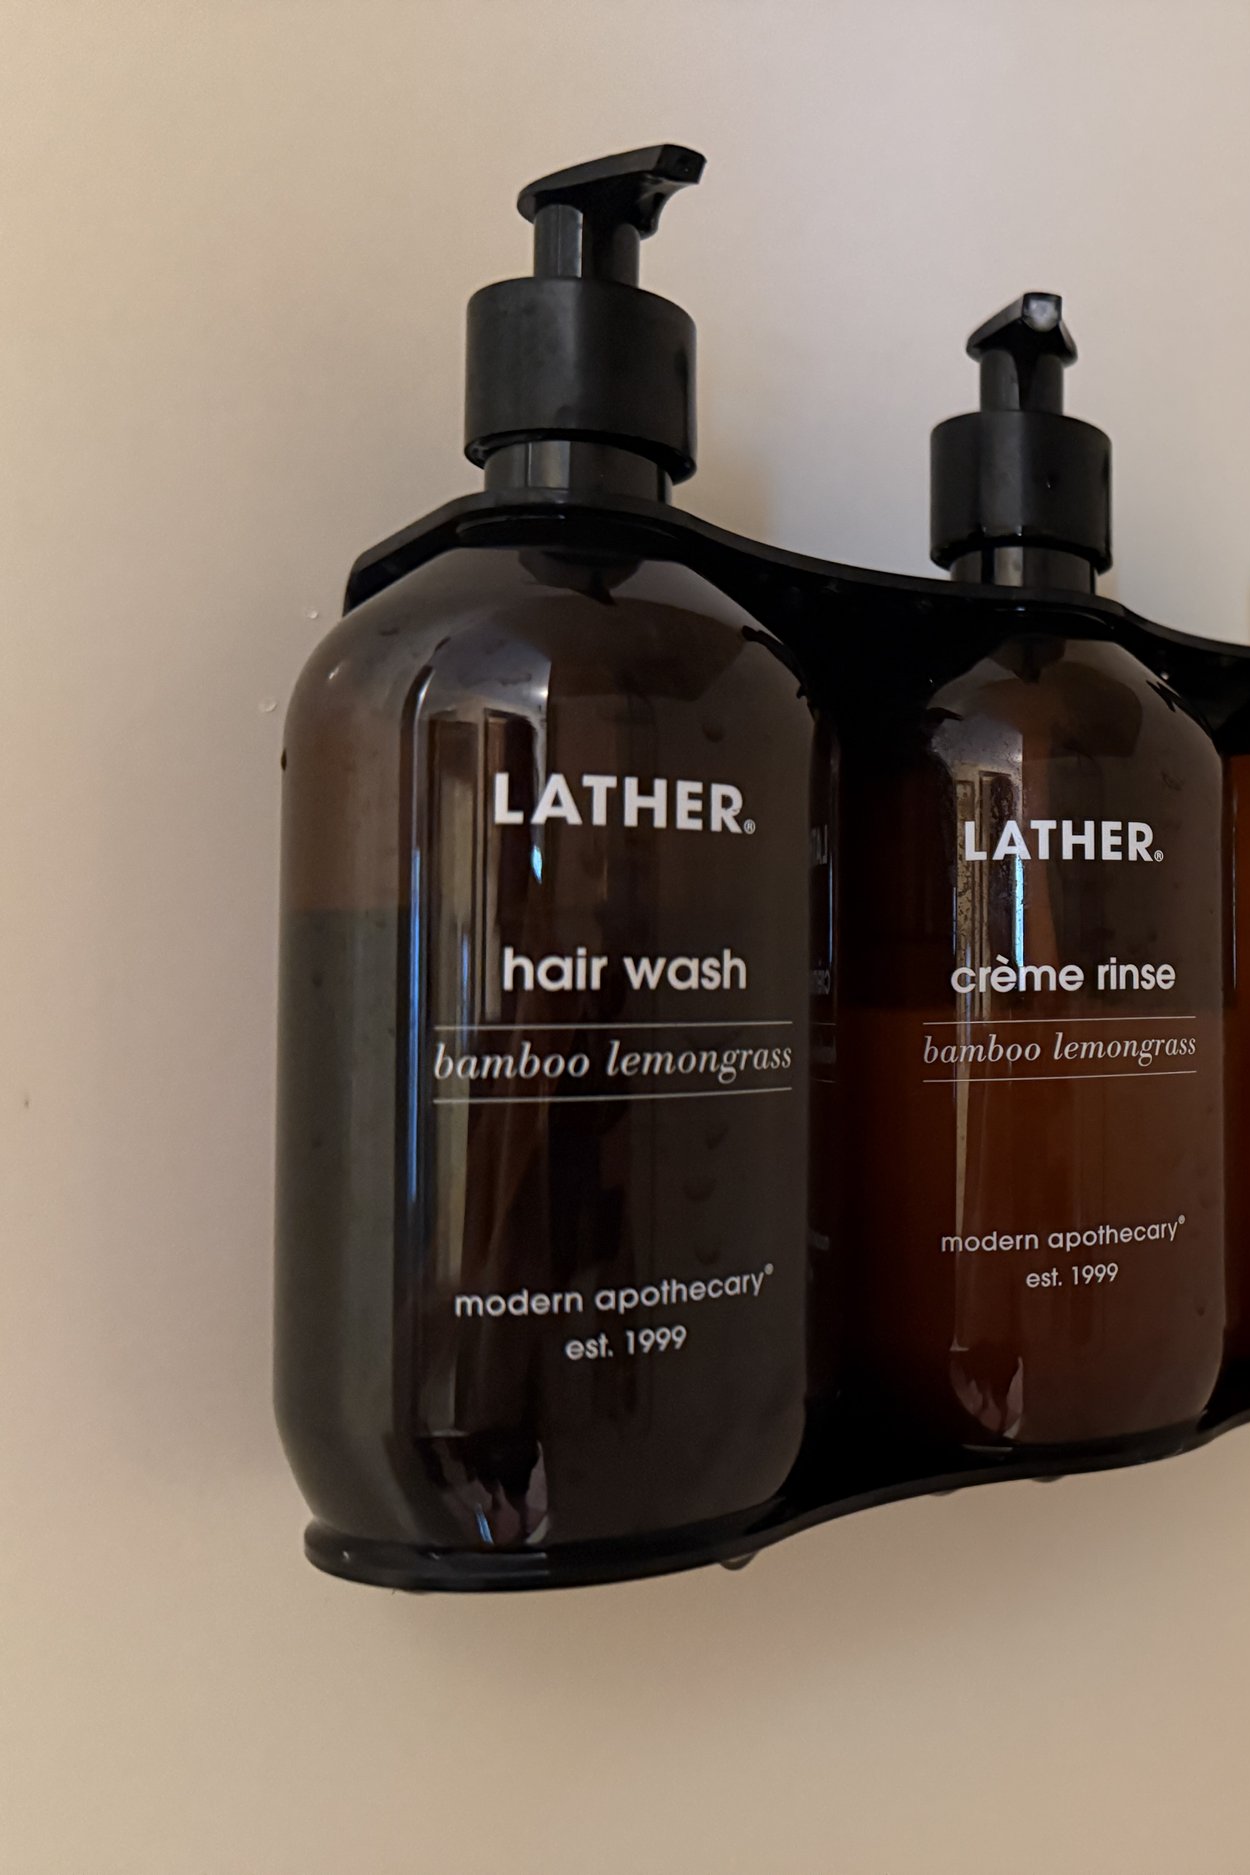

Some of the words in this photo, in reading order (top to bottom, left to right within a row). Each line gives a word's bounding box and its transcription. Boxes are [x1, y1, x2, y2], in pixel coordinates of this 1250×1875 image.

[502, 946, 609, 991] hair
[623, 948, 748, 991] wash
[950, 954, 1085, 994] crème
[1097, 956, 1177, 991] rinse
[433, 1041, 591, 1080] bamboo
[605, 1039, 793, 1085] lemongrass
[922, 1033, 1042, 1064] bamboo
[1052, 1032, 1197, 1067] lemongrass
[940, 1231, 1040, 1253] modern
[1025, 1267, 1063, 1289] est.
[1071, 1262, 1119, 1286] 1999
[453, 1288, 584, 1318] modern
[564, 1334, 615, 1361] est.
[625, 1324, 688, 1356] 1999
